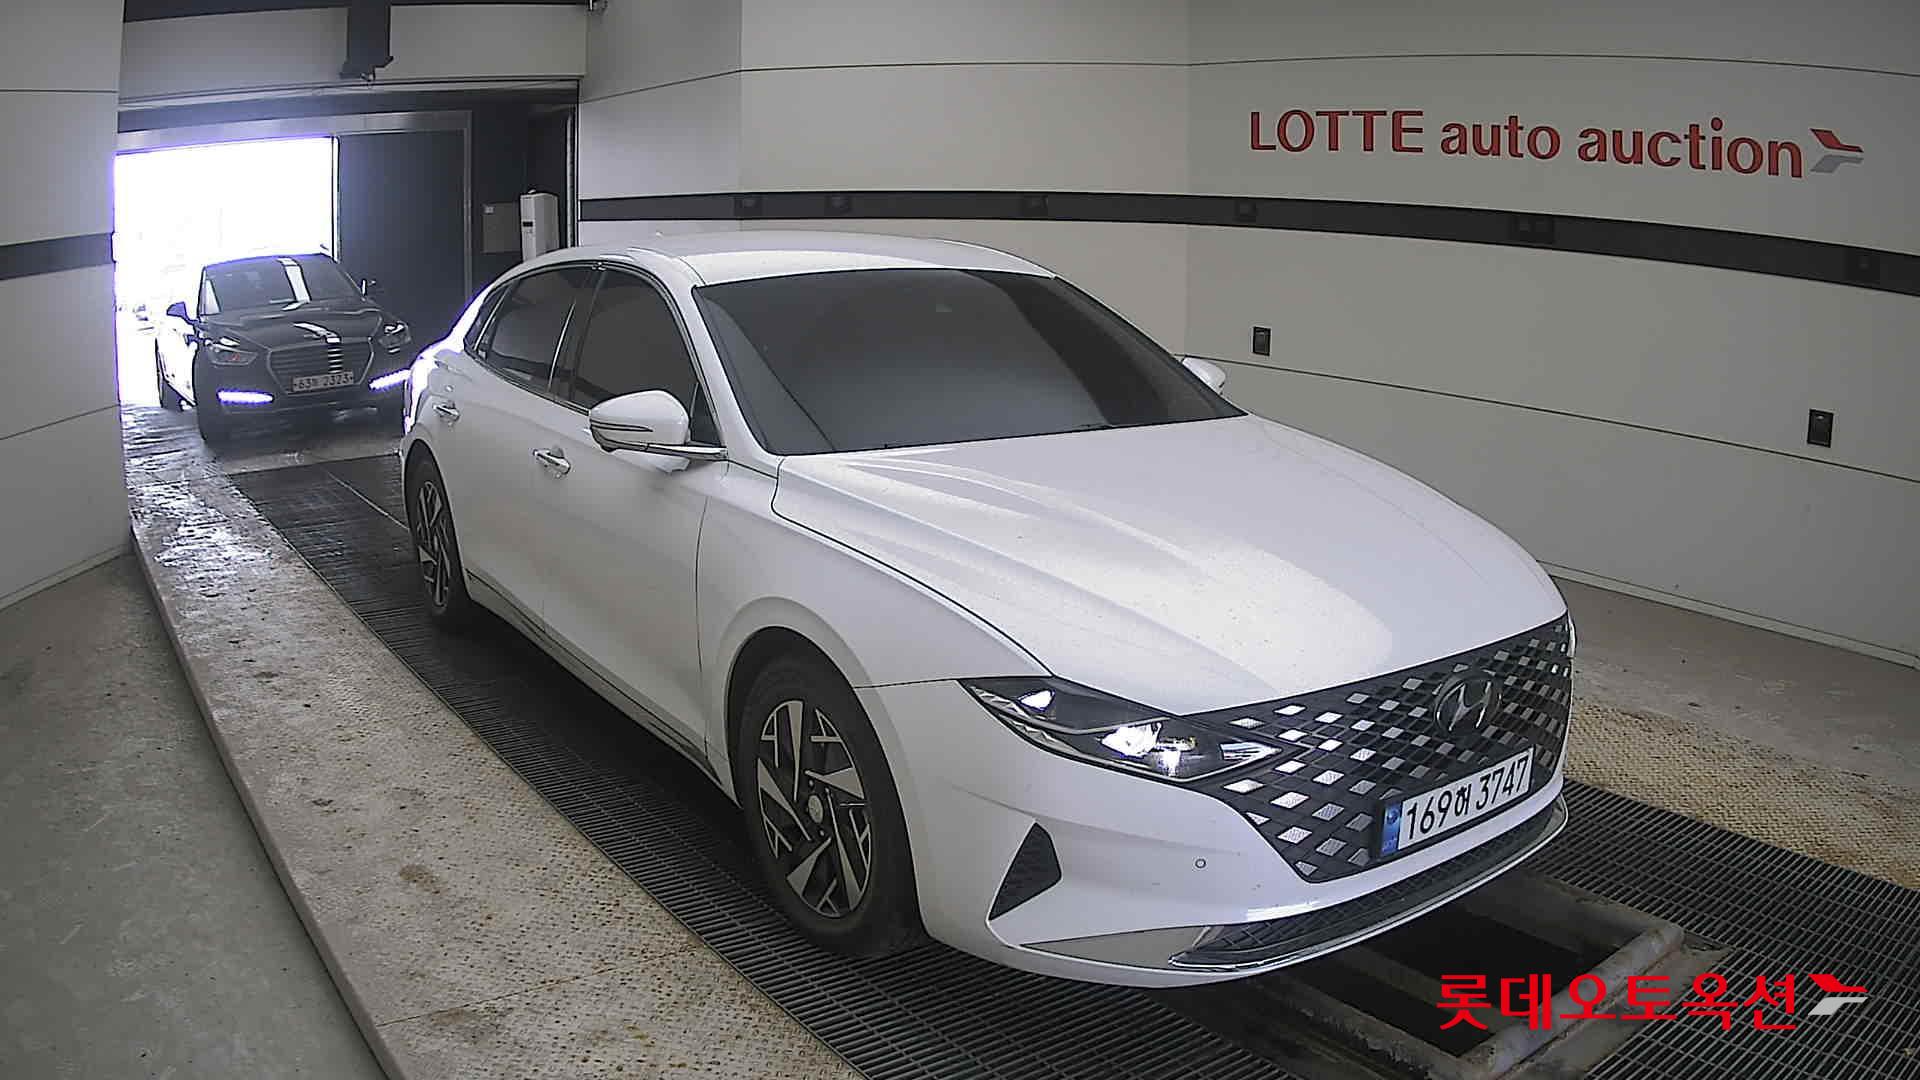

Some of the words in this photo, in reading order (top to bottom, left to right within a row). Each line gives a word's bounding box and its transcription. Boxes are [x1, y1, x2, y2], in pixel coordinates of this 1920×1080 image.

[1250, 109, 1424, 153] LOTTE
[1440, 115, 1561, 161] auto
[1576, 117, 1803, 179] auction
[1406, 783, 1472, 840] 169허
[1475, 756, 1529, 811] 3747
